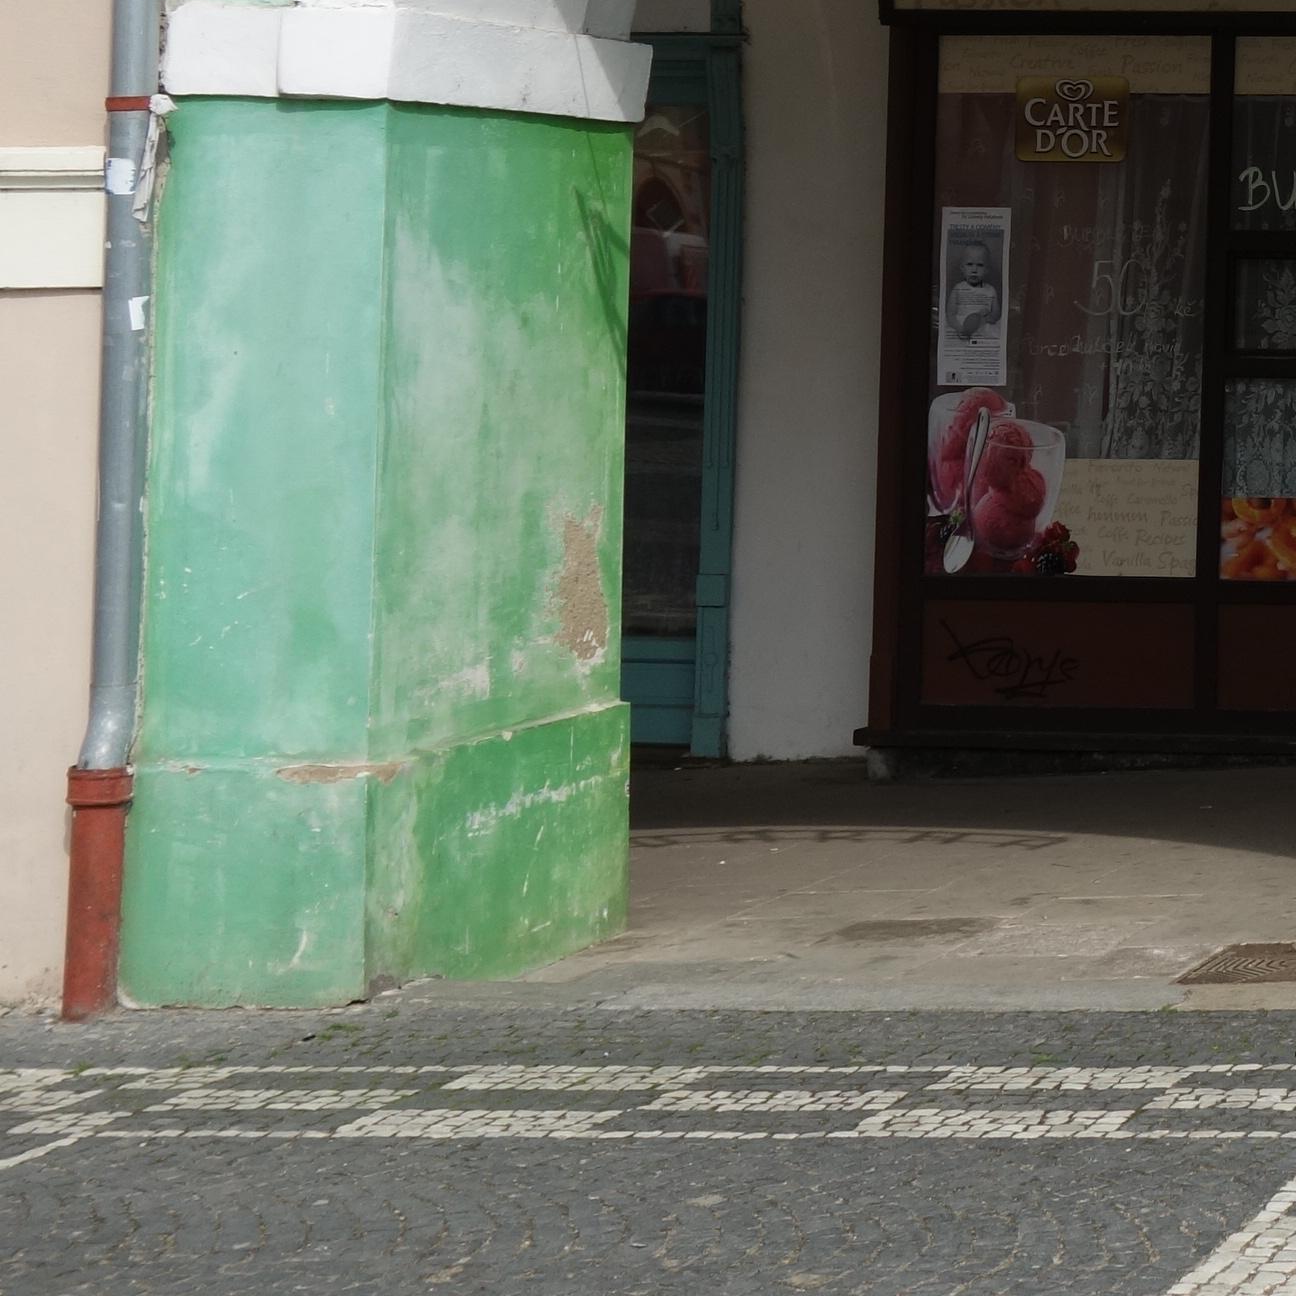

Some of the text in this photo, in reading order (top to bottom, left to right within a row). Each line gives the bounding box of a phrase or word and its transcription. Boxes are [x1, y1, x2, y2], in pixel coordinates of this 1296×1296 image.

[1023, 97, 1120, 131] CARTE
[1035, 126, 1113, 159] D'OR
[1072, 258, 1148, 317] 50
